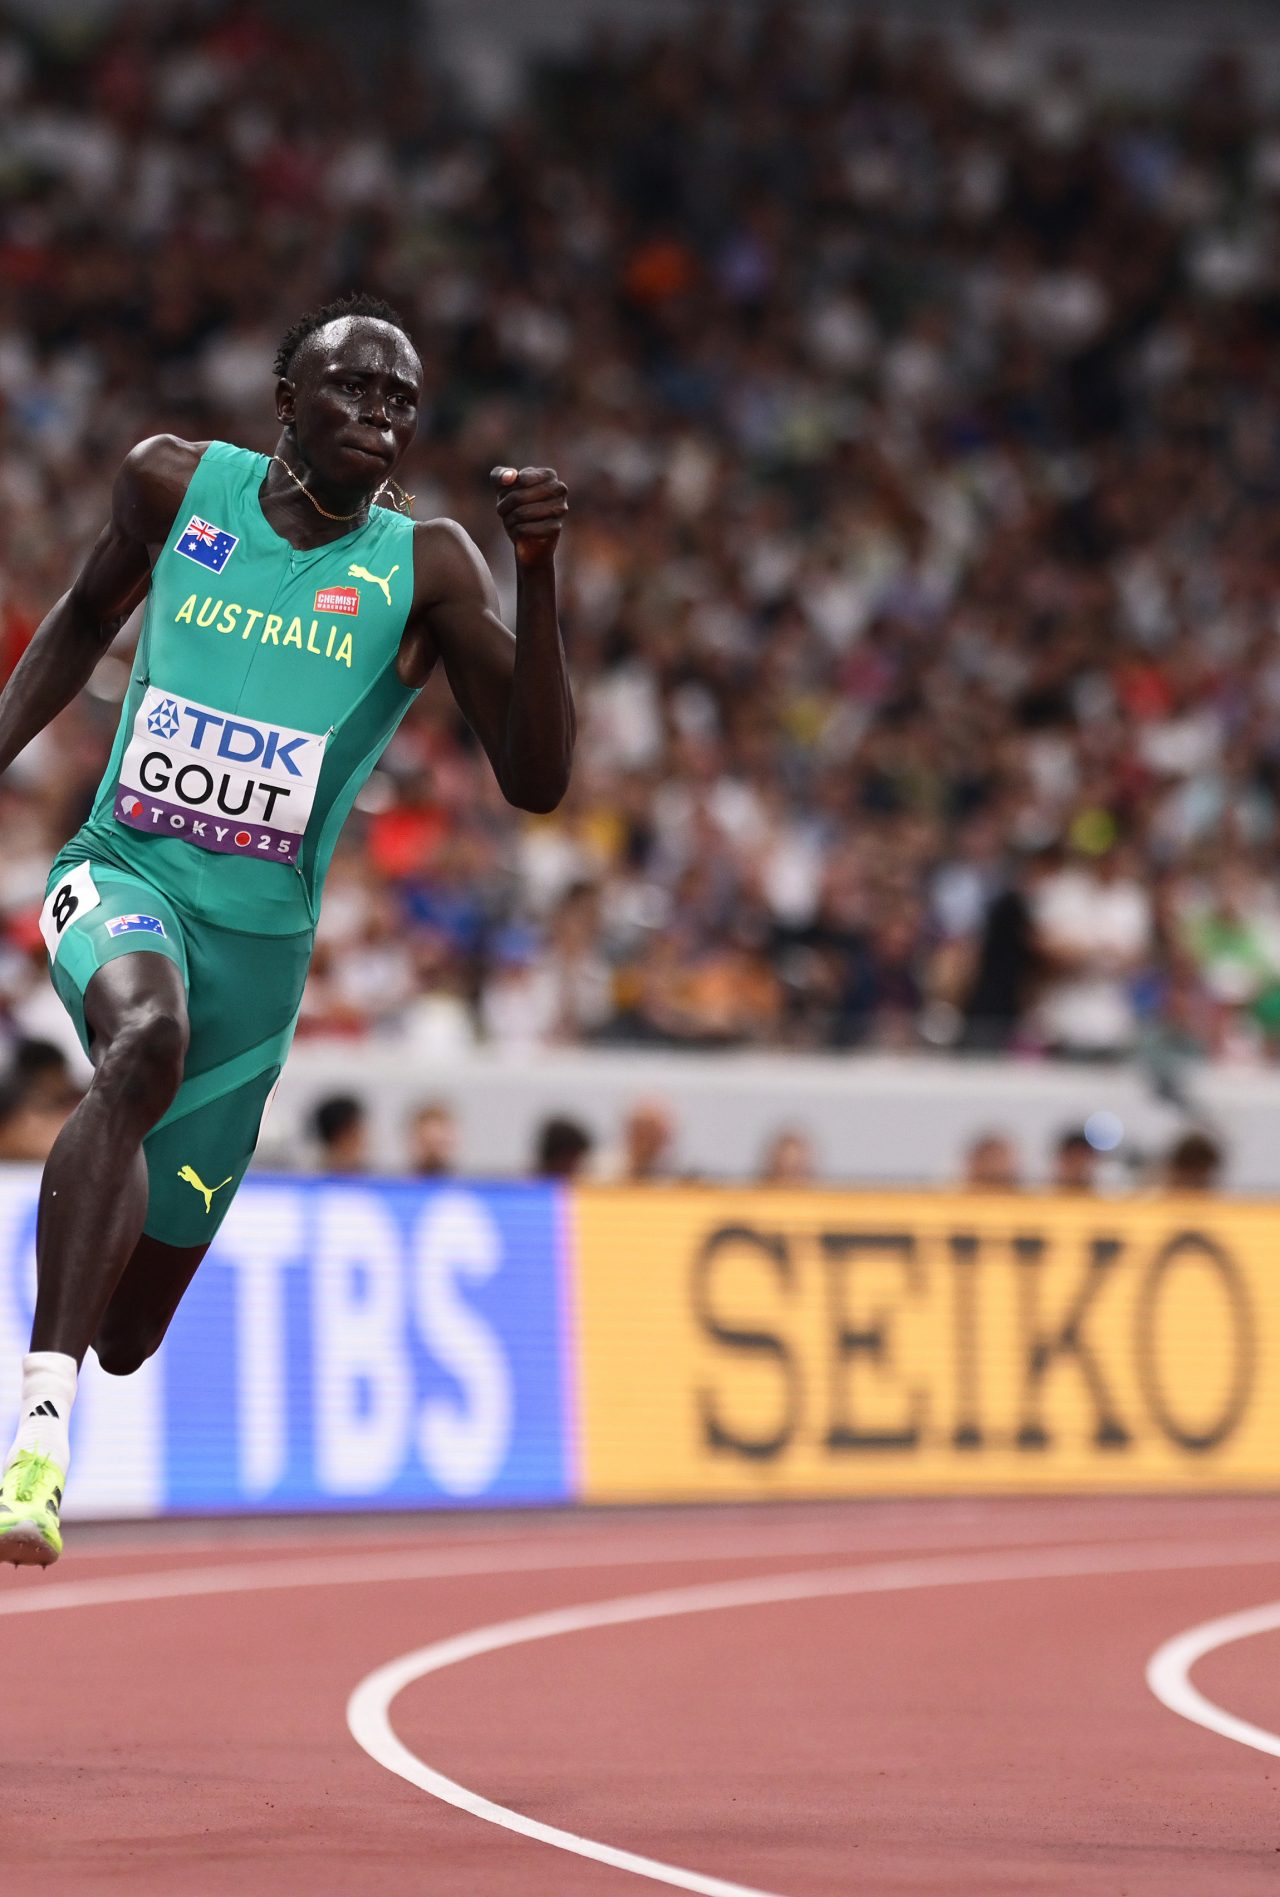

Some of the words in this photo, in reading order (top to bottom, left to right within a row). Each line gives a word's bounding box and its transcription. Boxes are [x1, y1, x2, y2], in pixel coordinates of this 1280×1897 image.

[174, 594, 352, 668] AUSTRALIA
[318, 593, 357, 606] CHEMIST
[183, 706, 310, 777] TDK
[139, 751, 291, 822] GOUT
[52, 884, 79, 934] 8
[208, 1184, 516, 1501] TBS
[690, 1224, 1256, 1460] SEIKO
